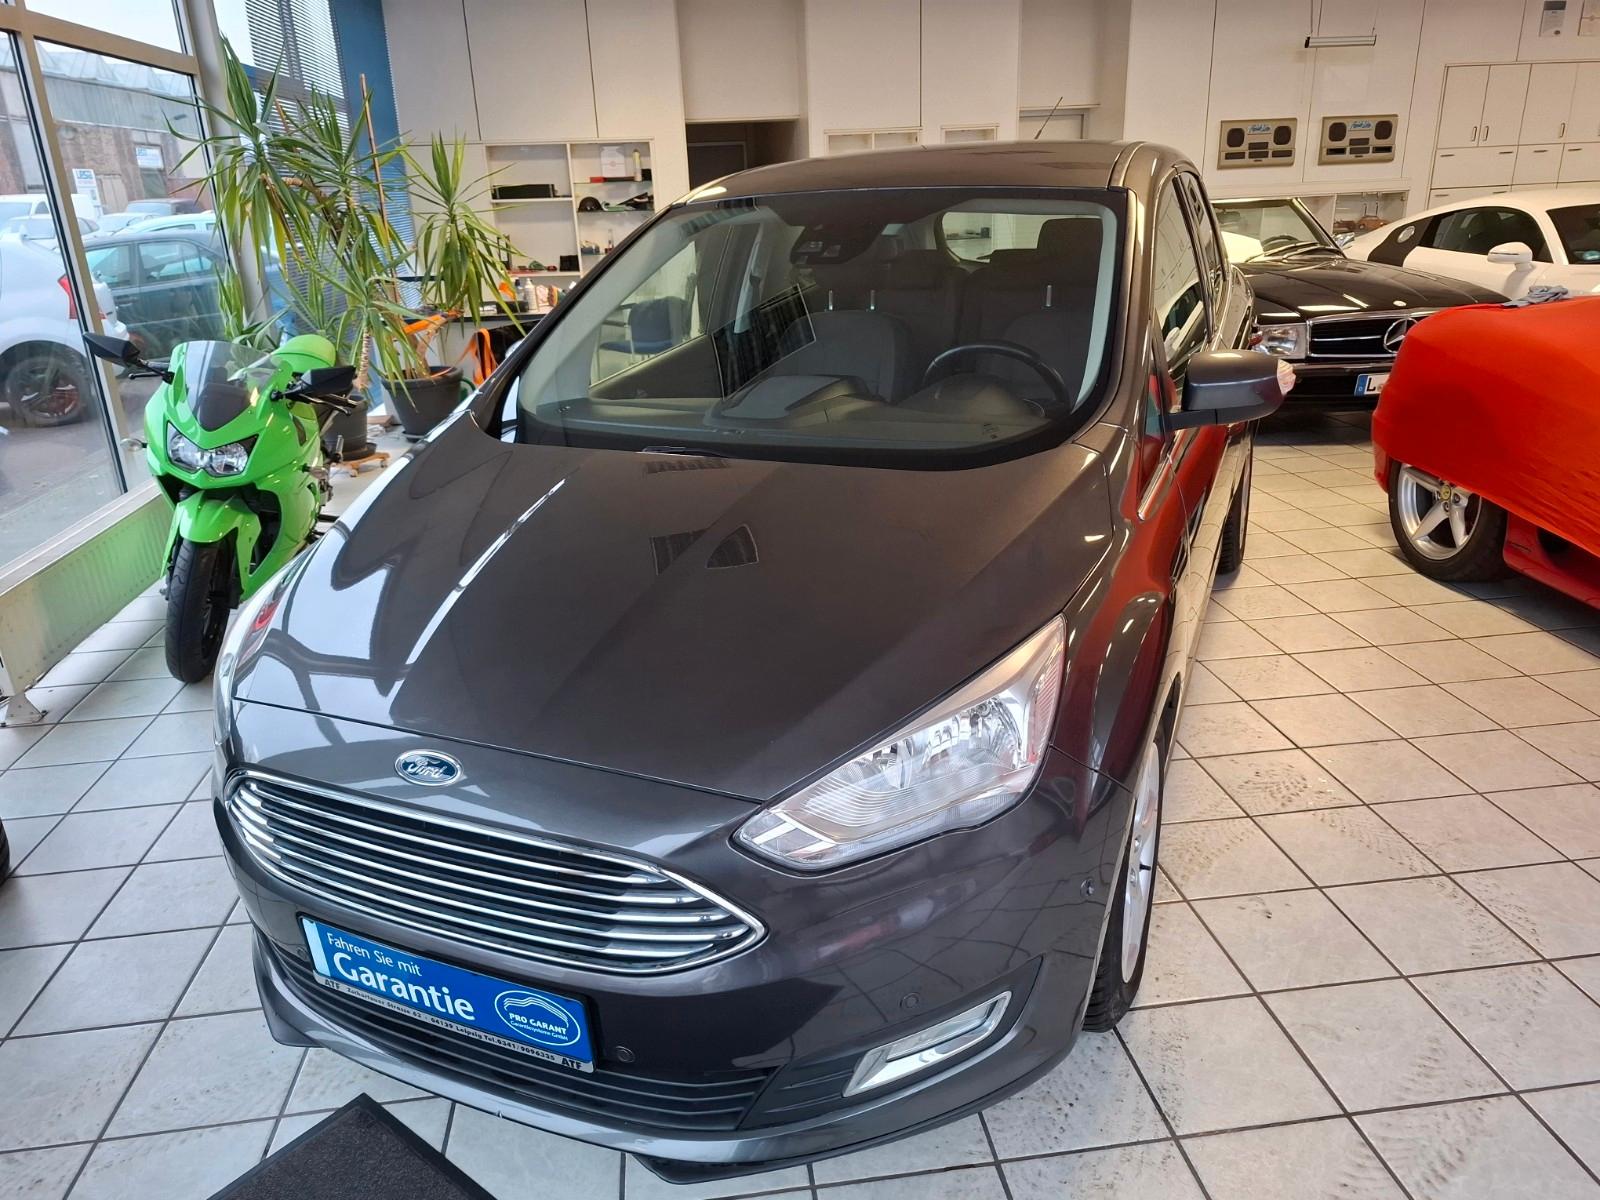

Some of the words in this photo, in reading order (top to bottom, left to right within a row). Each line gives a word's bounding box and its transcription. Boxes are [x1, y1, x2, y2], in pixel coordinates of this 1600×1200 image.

[406, 757, 448, 779] Ford
[326, 932, 371, 959] Fahren
[373, 950, 395, 968] Sie
[397, 960, 423, 977] mit
[333, 952, 476, 1021] Garantie
[324, 979, 341, 990] ATF
[561, 1057, 583, 1070] ATF
[508, 1012, 528, 1024] PRO
[529, 1018, 567, 1035] GARANT
